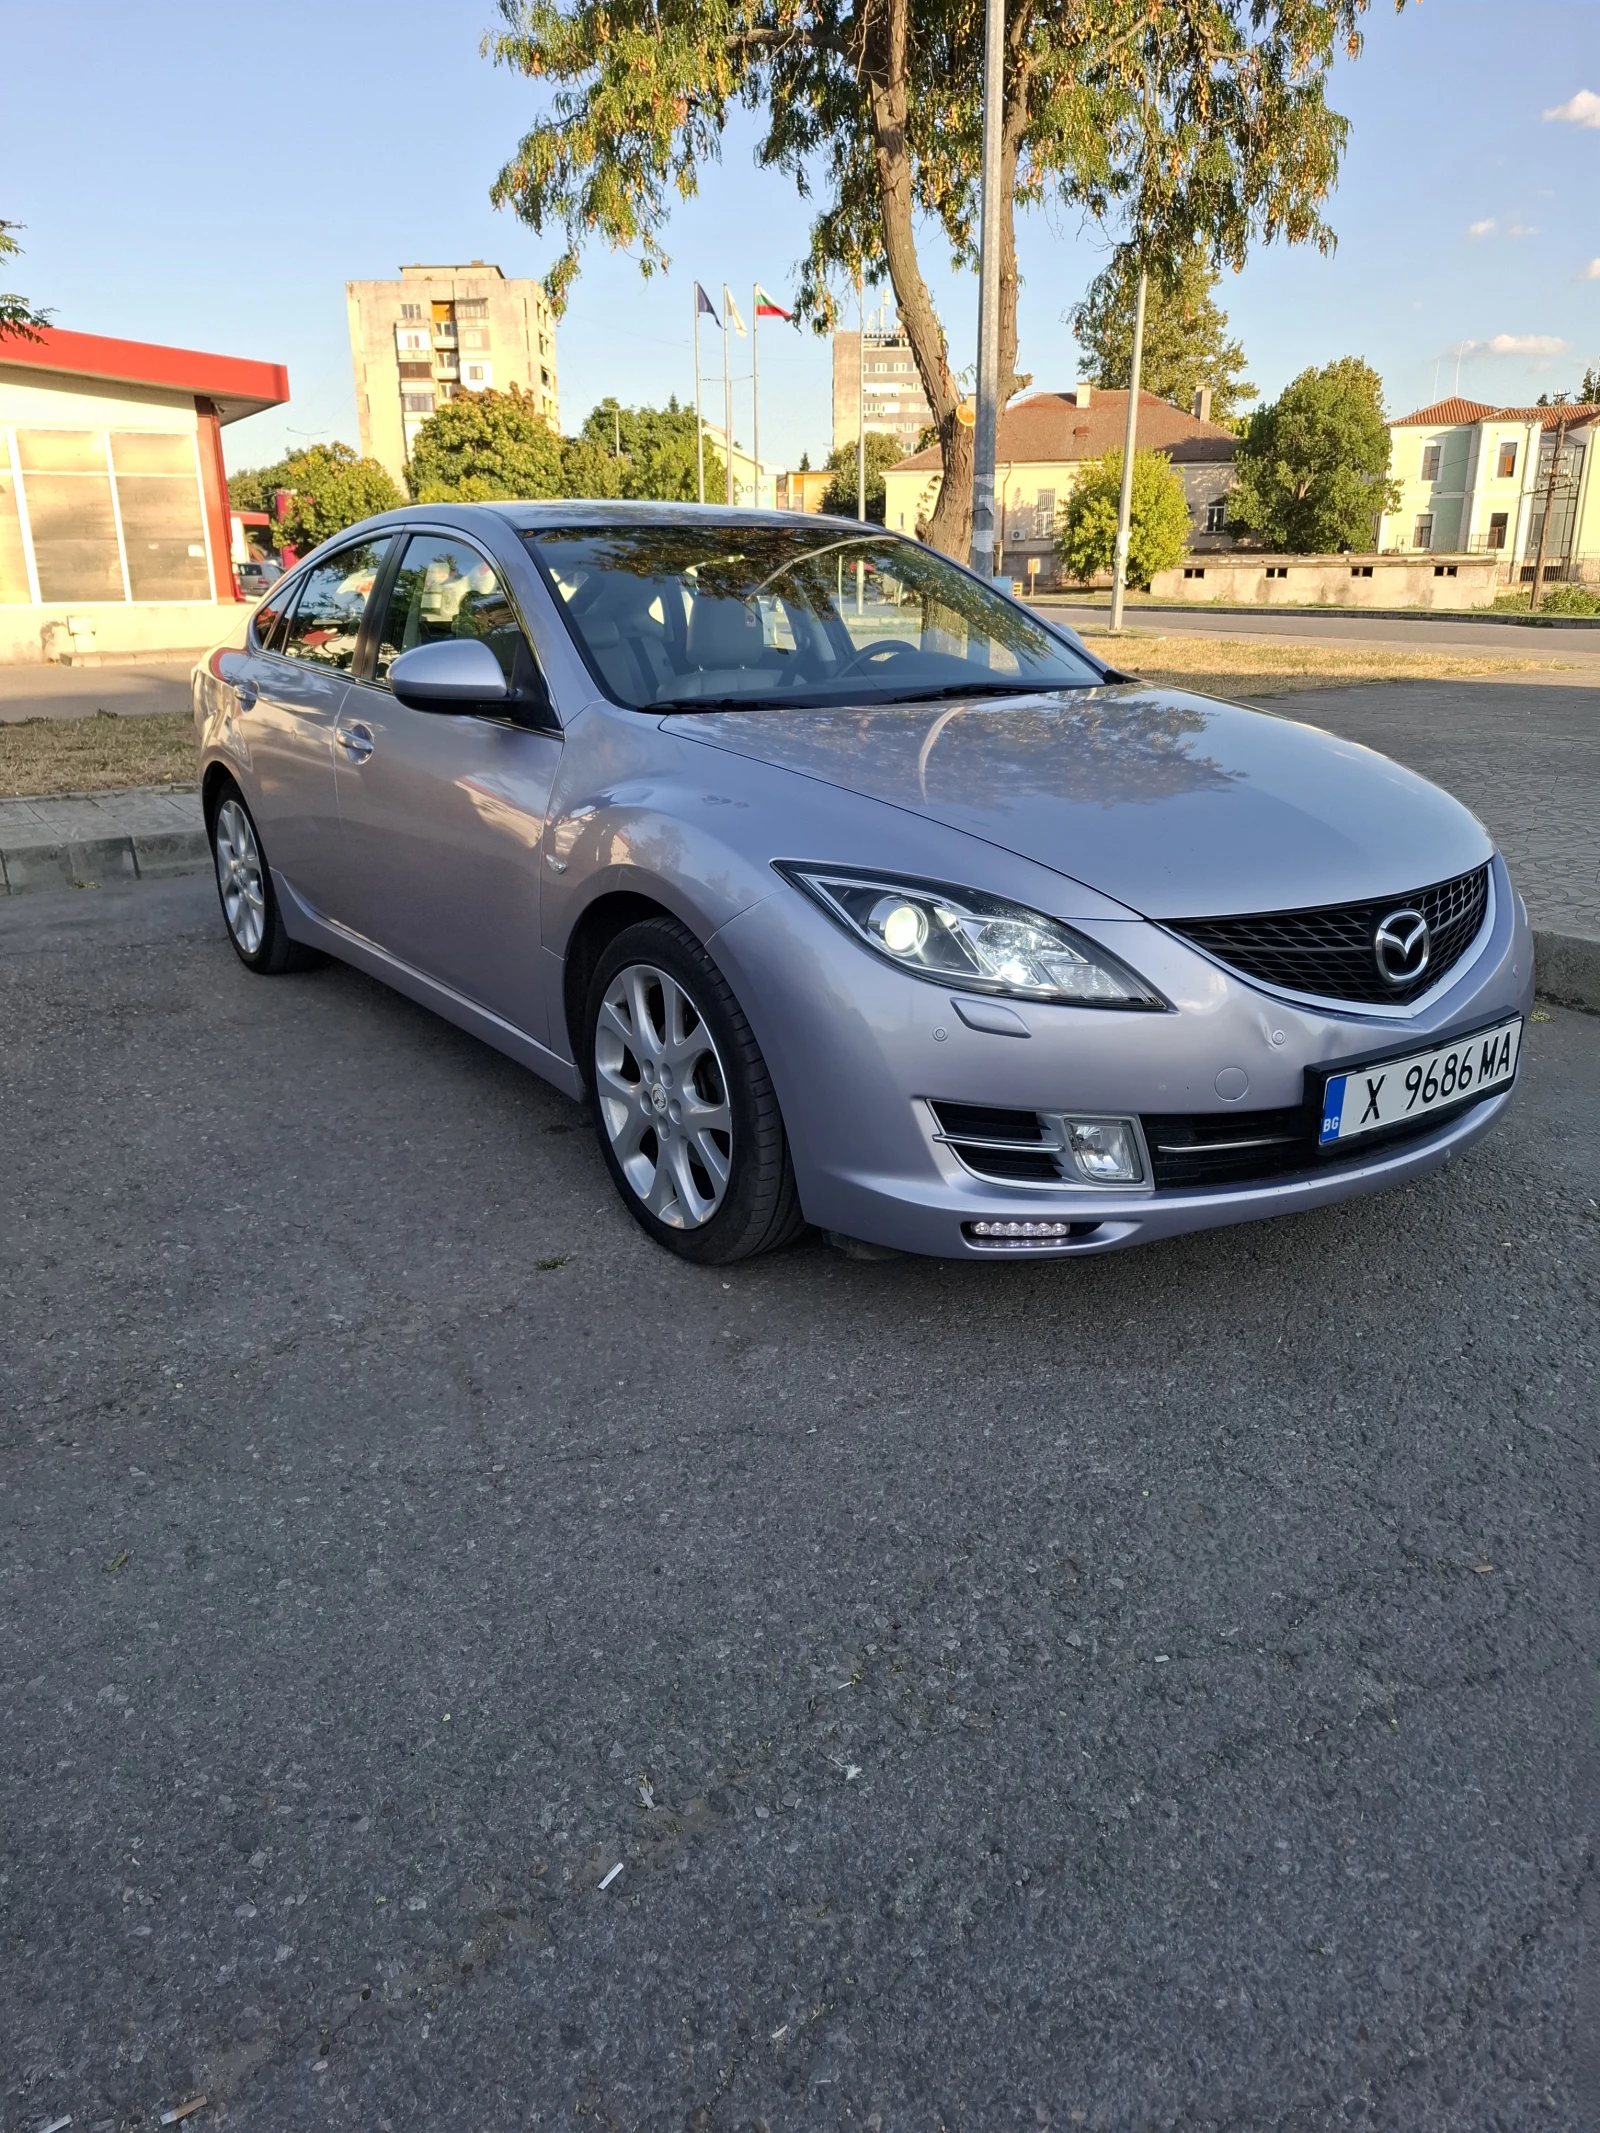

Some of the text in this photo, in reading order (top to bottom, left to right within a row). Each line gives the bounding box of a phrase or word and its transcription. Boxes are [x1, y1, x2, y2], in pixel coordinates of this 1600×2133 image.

[1360, 1031, 1511, 1124] X 9686 MA
[1322, 1116, 1340, 1133] BG
